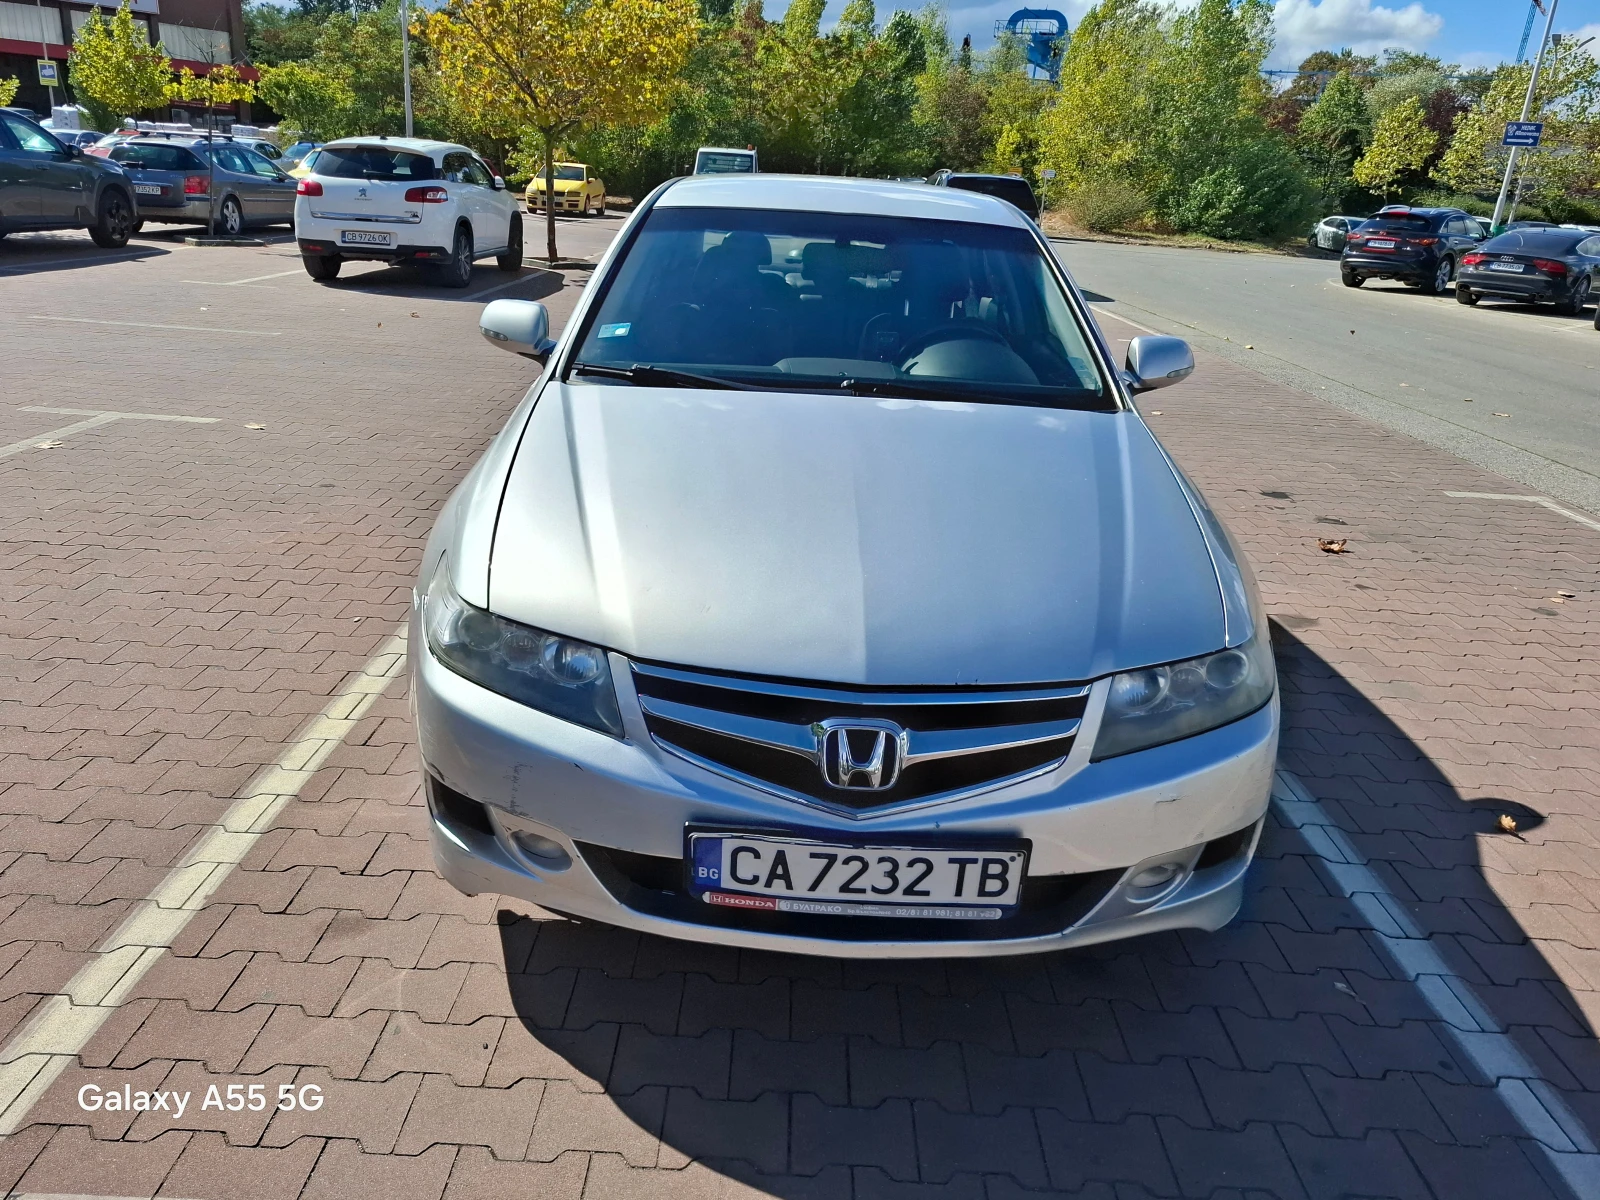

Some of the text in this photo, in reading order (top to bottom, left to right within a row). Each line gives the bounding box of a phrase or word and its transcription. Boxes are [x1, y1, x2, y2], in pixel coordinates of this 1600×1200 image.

[346, 232, 388, 243] CB 9726 OK
[698, 866, 720, 880] BG
[730, 845, 1010, 897] CA 7232 TB
[725, 897, 775, 908] HONDA
[793, 903, 842, 913] БУЛТРАКО
[922, 909, 933, 917] 81
